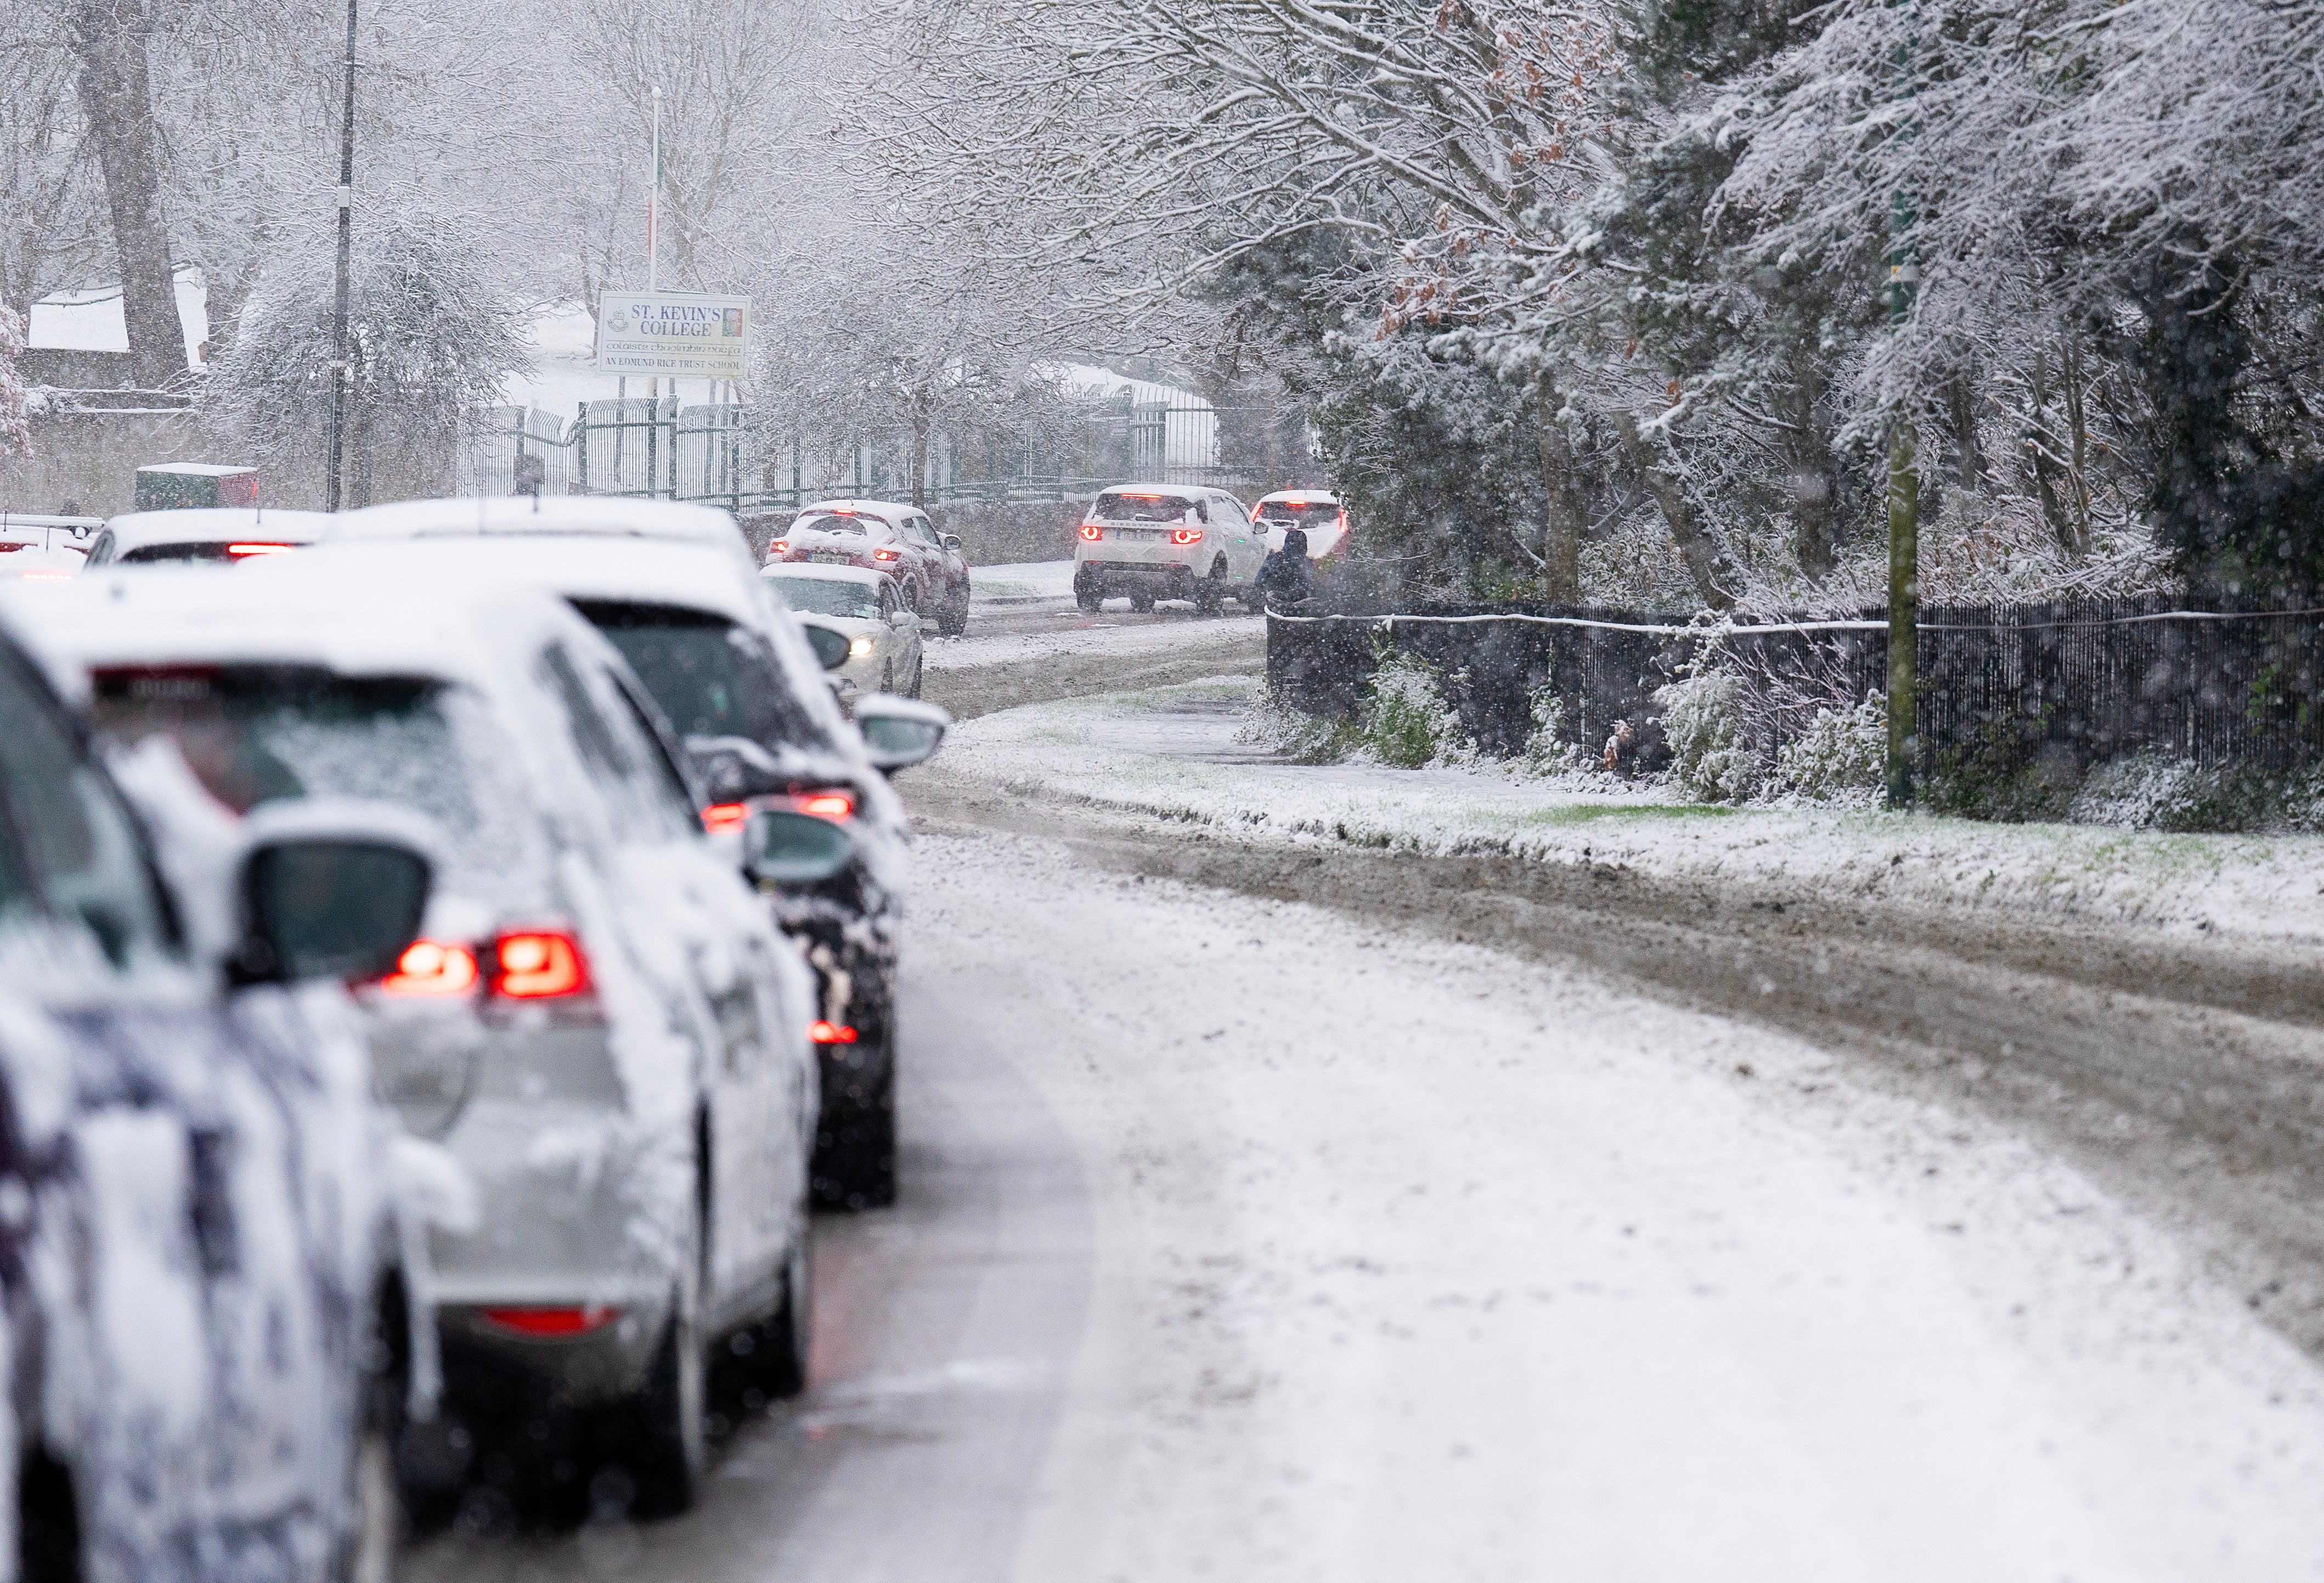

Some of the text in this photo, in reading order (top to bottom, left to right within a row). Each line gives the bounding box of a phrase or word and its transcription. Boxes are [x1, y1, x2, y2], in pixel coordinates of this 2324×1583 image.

[631, 304, 720, 322] ST. KEVIN'S
[640, 321, 712, 337] COLLEGE
[605, 357, 740, 370] AN EDMUND RICE TRUST SCHOOL
